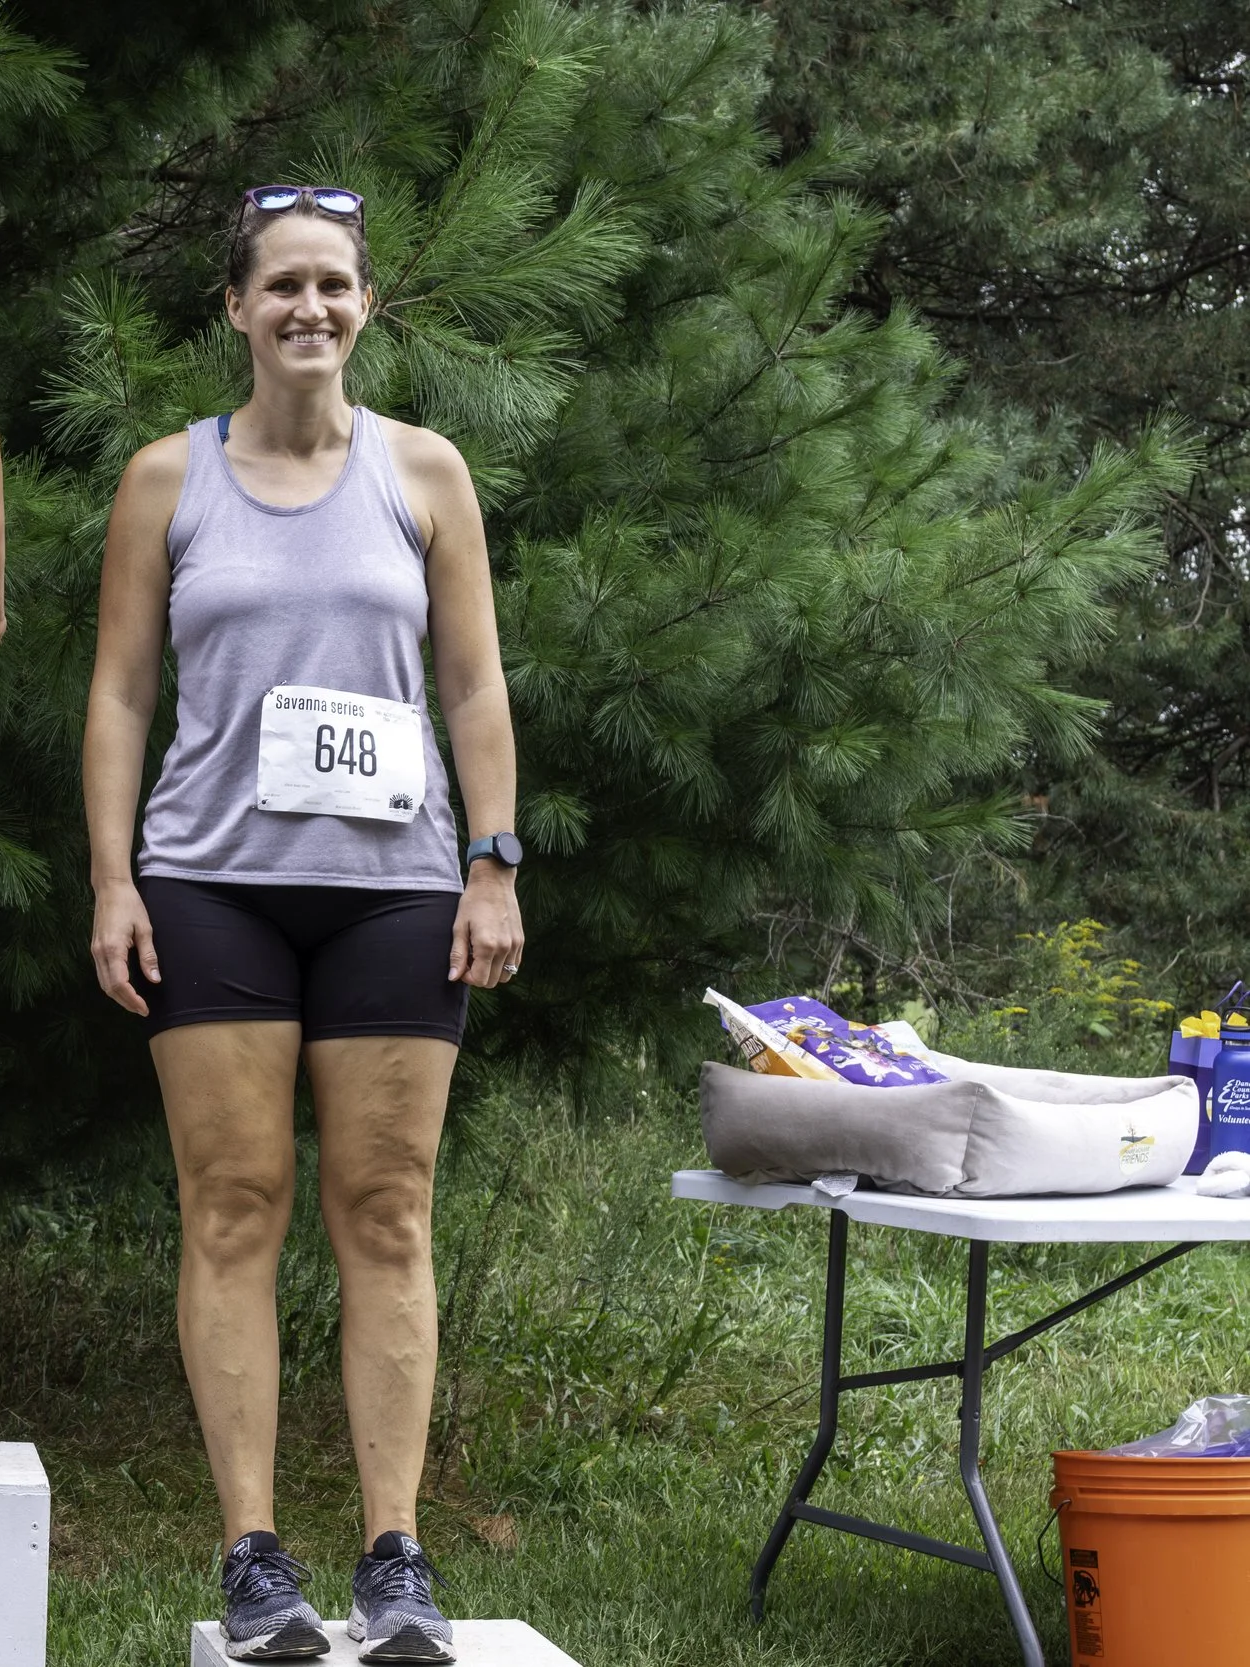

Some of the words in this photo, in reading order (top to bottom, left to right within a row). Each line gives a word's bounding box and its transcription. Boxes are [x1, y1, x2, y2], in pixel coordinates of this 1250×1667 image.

[275, 694, 327, 712] Savanna
[331, 701, 365, 718] series
[315, 724, 377, 777] 648
